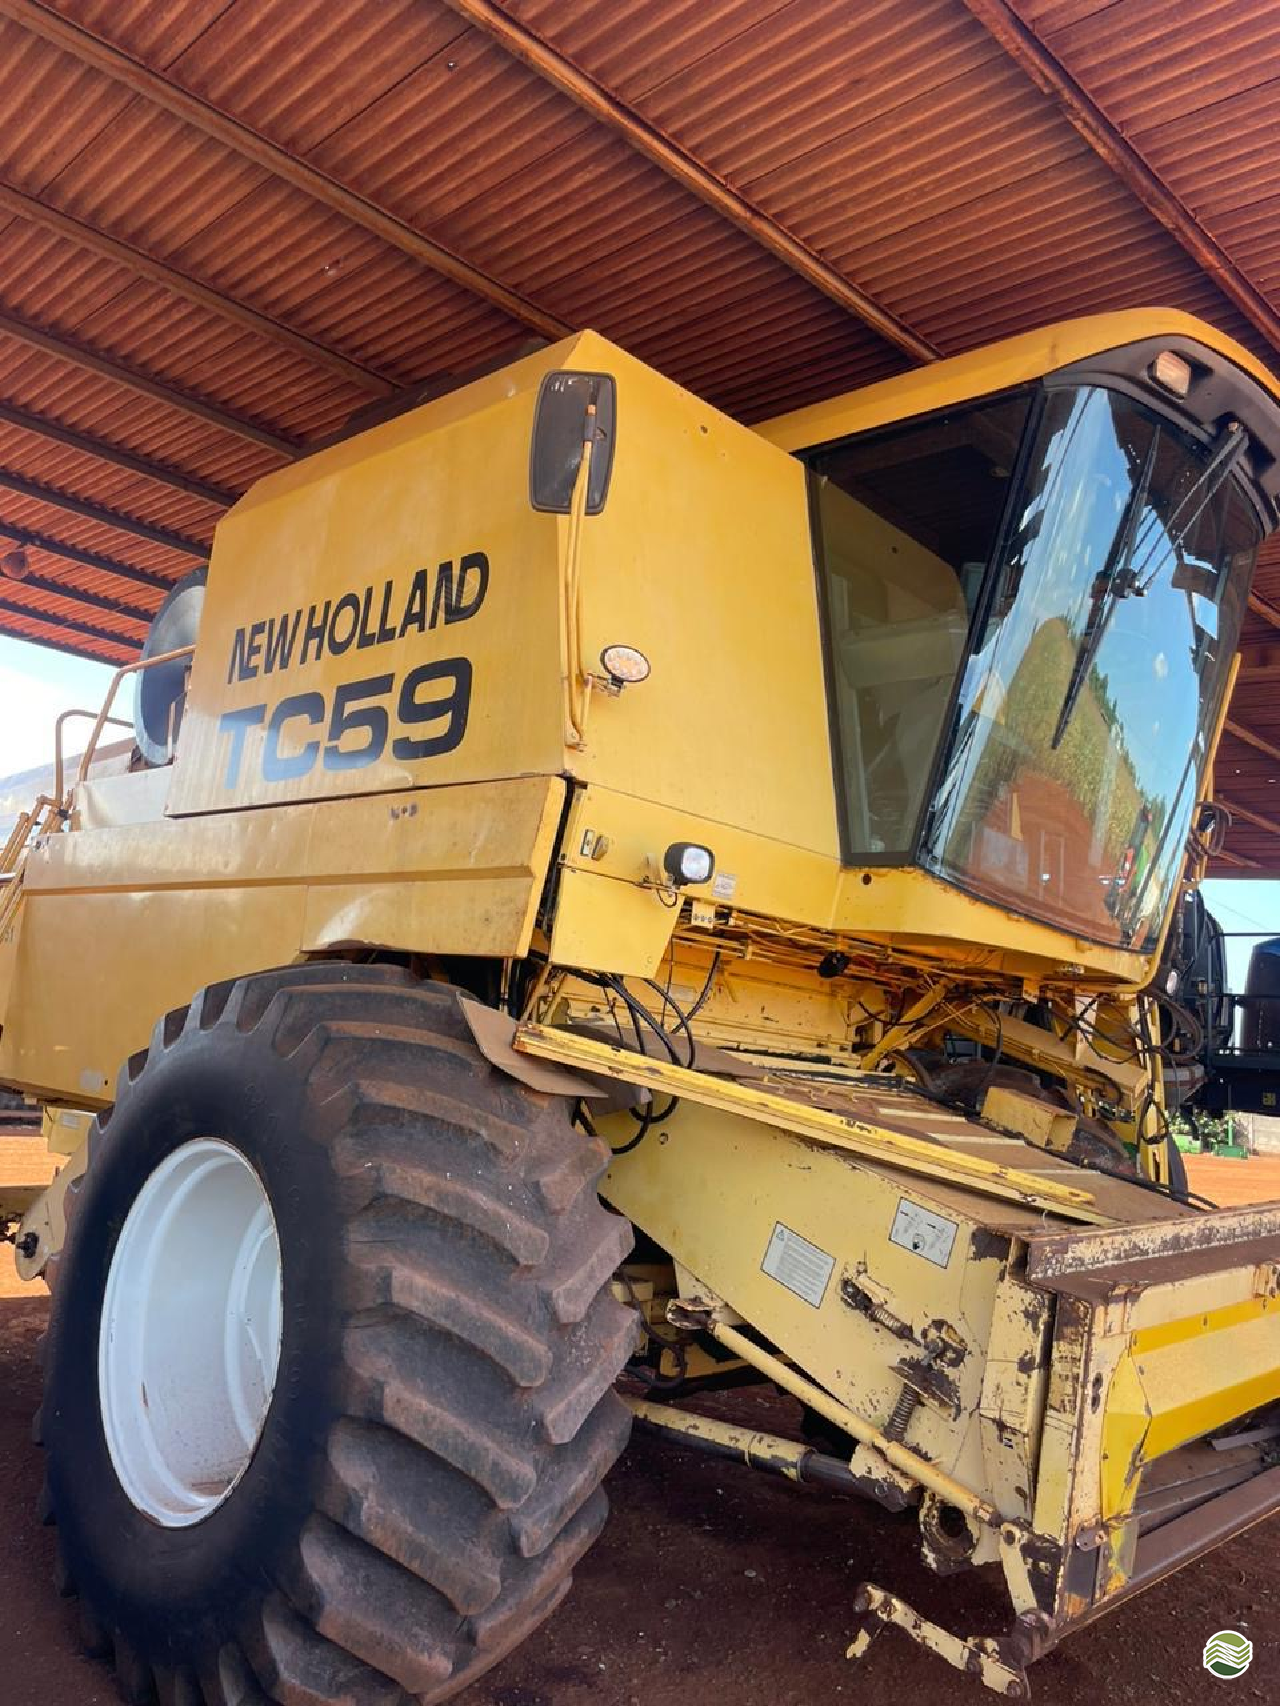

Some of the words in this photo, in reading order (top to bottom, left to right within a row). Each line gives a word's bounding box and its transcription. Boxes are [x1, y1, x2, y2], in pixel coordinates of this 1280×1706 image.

[227, 609, 303, 684] NEW
[300, 551, 489, 664] HOLLAND
[218, 657, 473, 789] TC59
